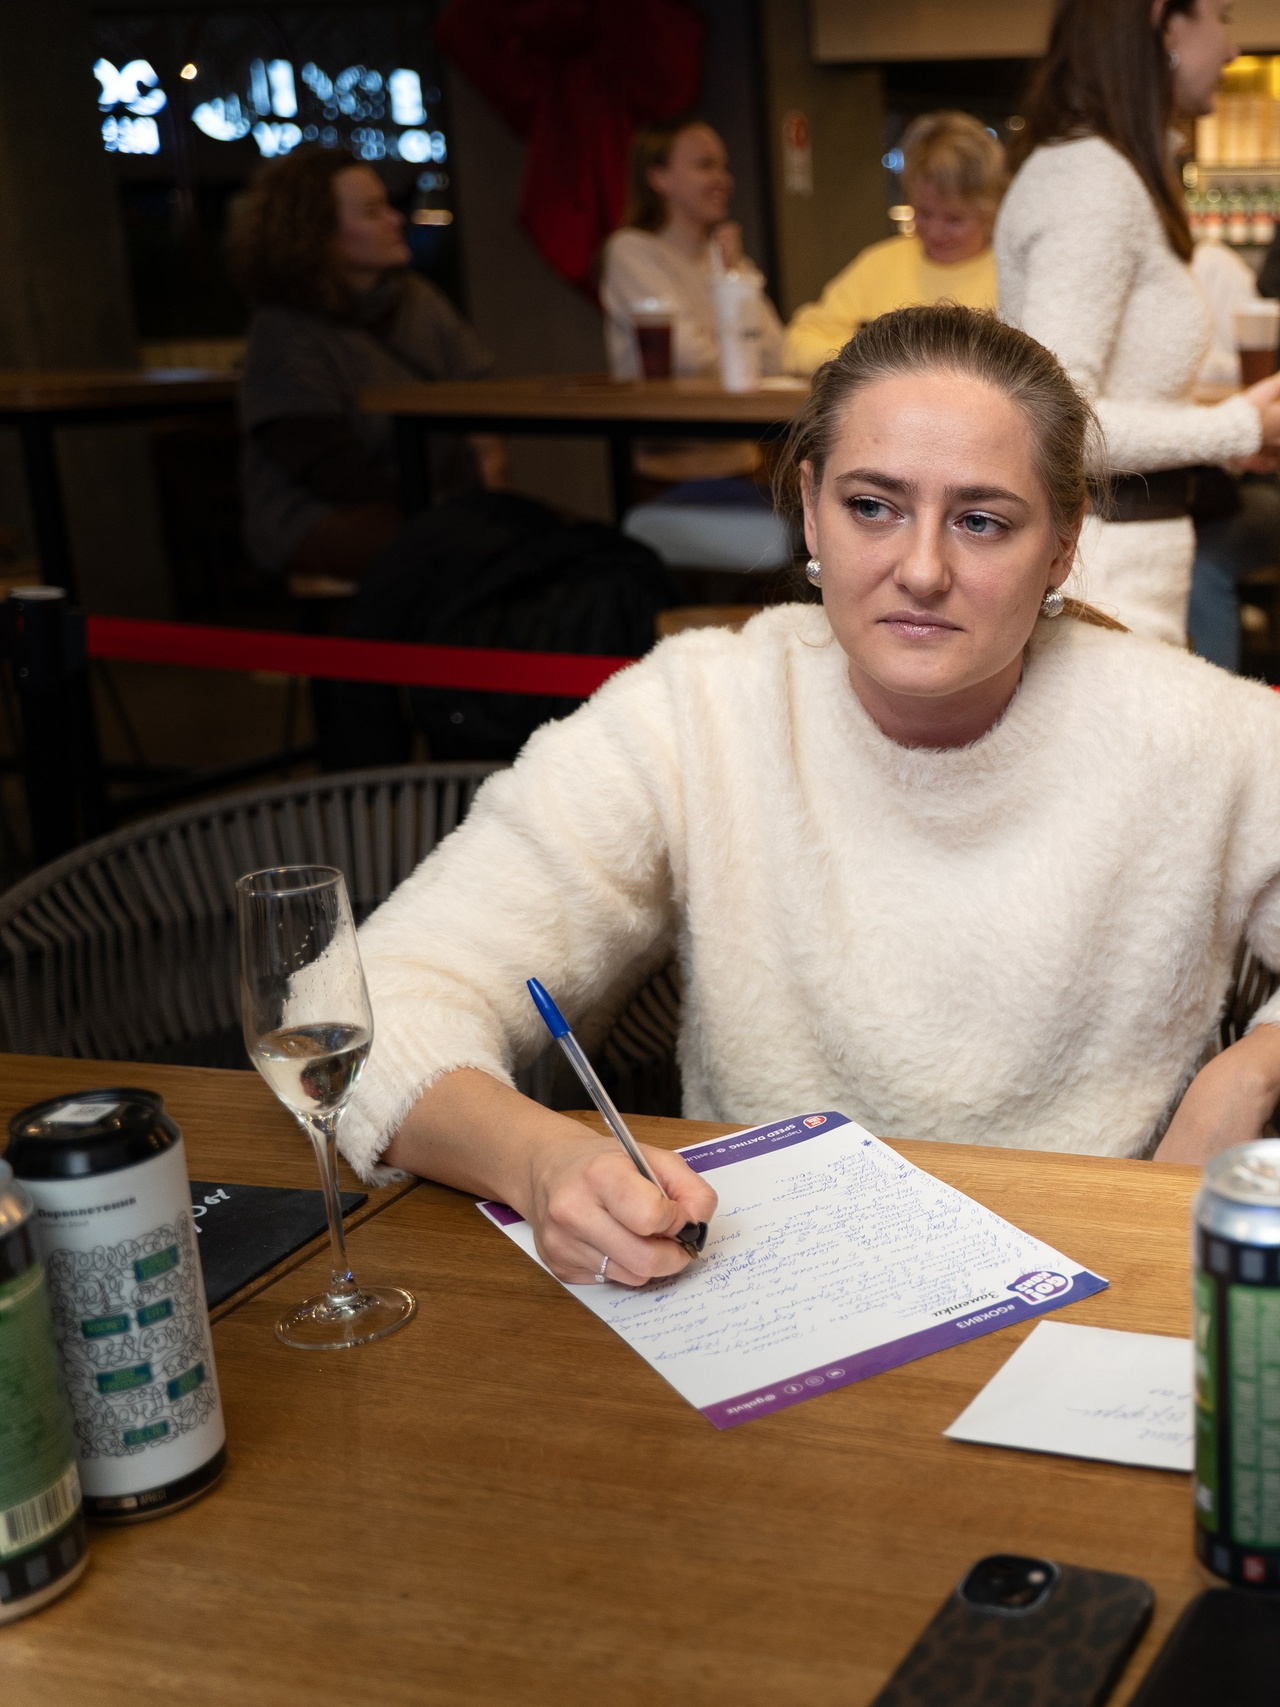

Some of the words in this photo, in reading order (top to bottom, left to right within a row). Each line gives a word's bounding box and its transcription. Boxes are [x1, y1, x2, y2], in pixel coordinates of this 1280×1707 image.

[728, 1134, 766, 1151] DATING
[765, 1123, 796, 1139] SPEED
[1015, 1271, 1052, 1292] КВИЗ
[1024, 1275, 1067, 1300] GO!
[931, 1290, 999, 1322] Заметки
[725, 1391, 777, 1417] @gokviz
